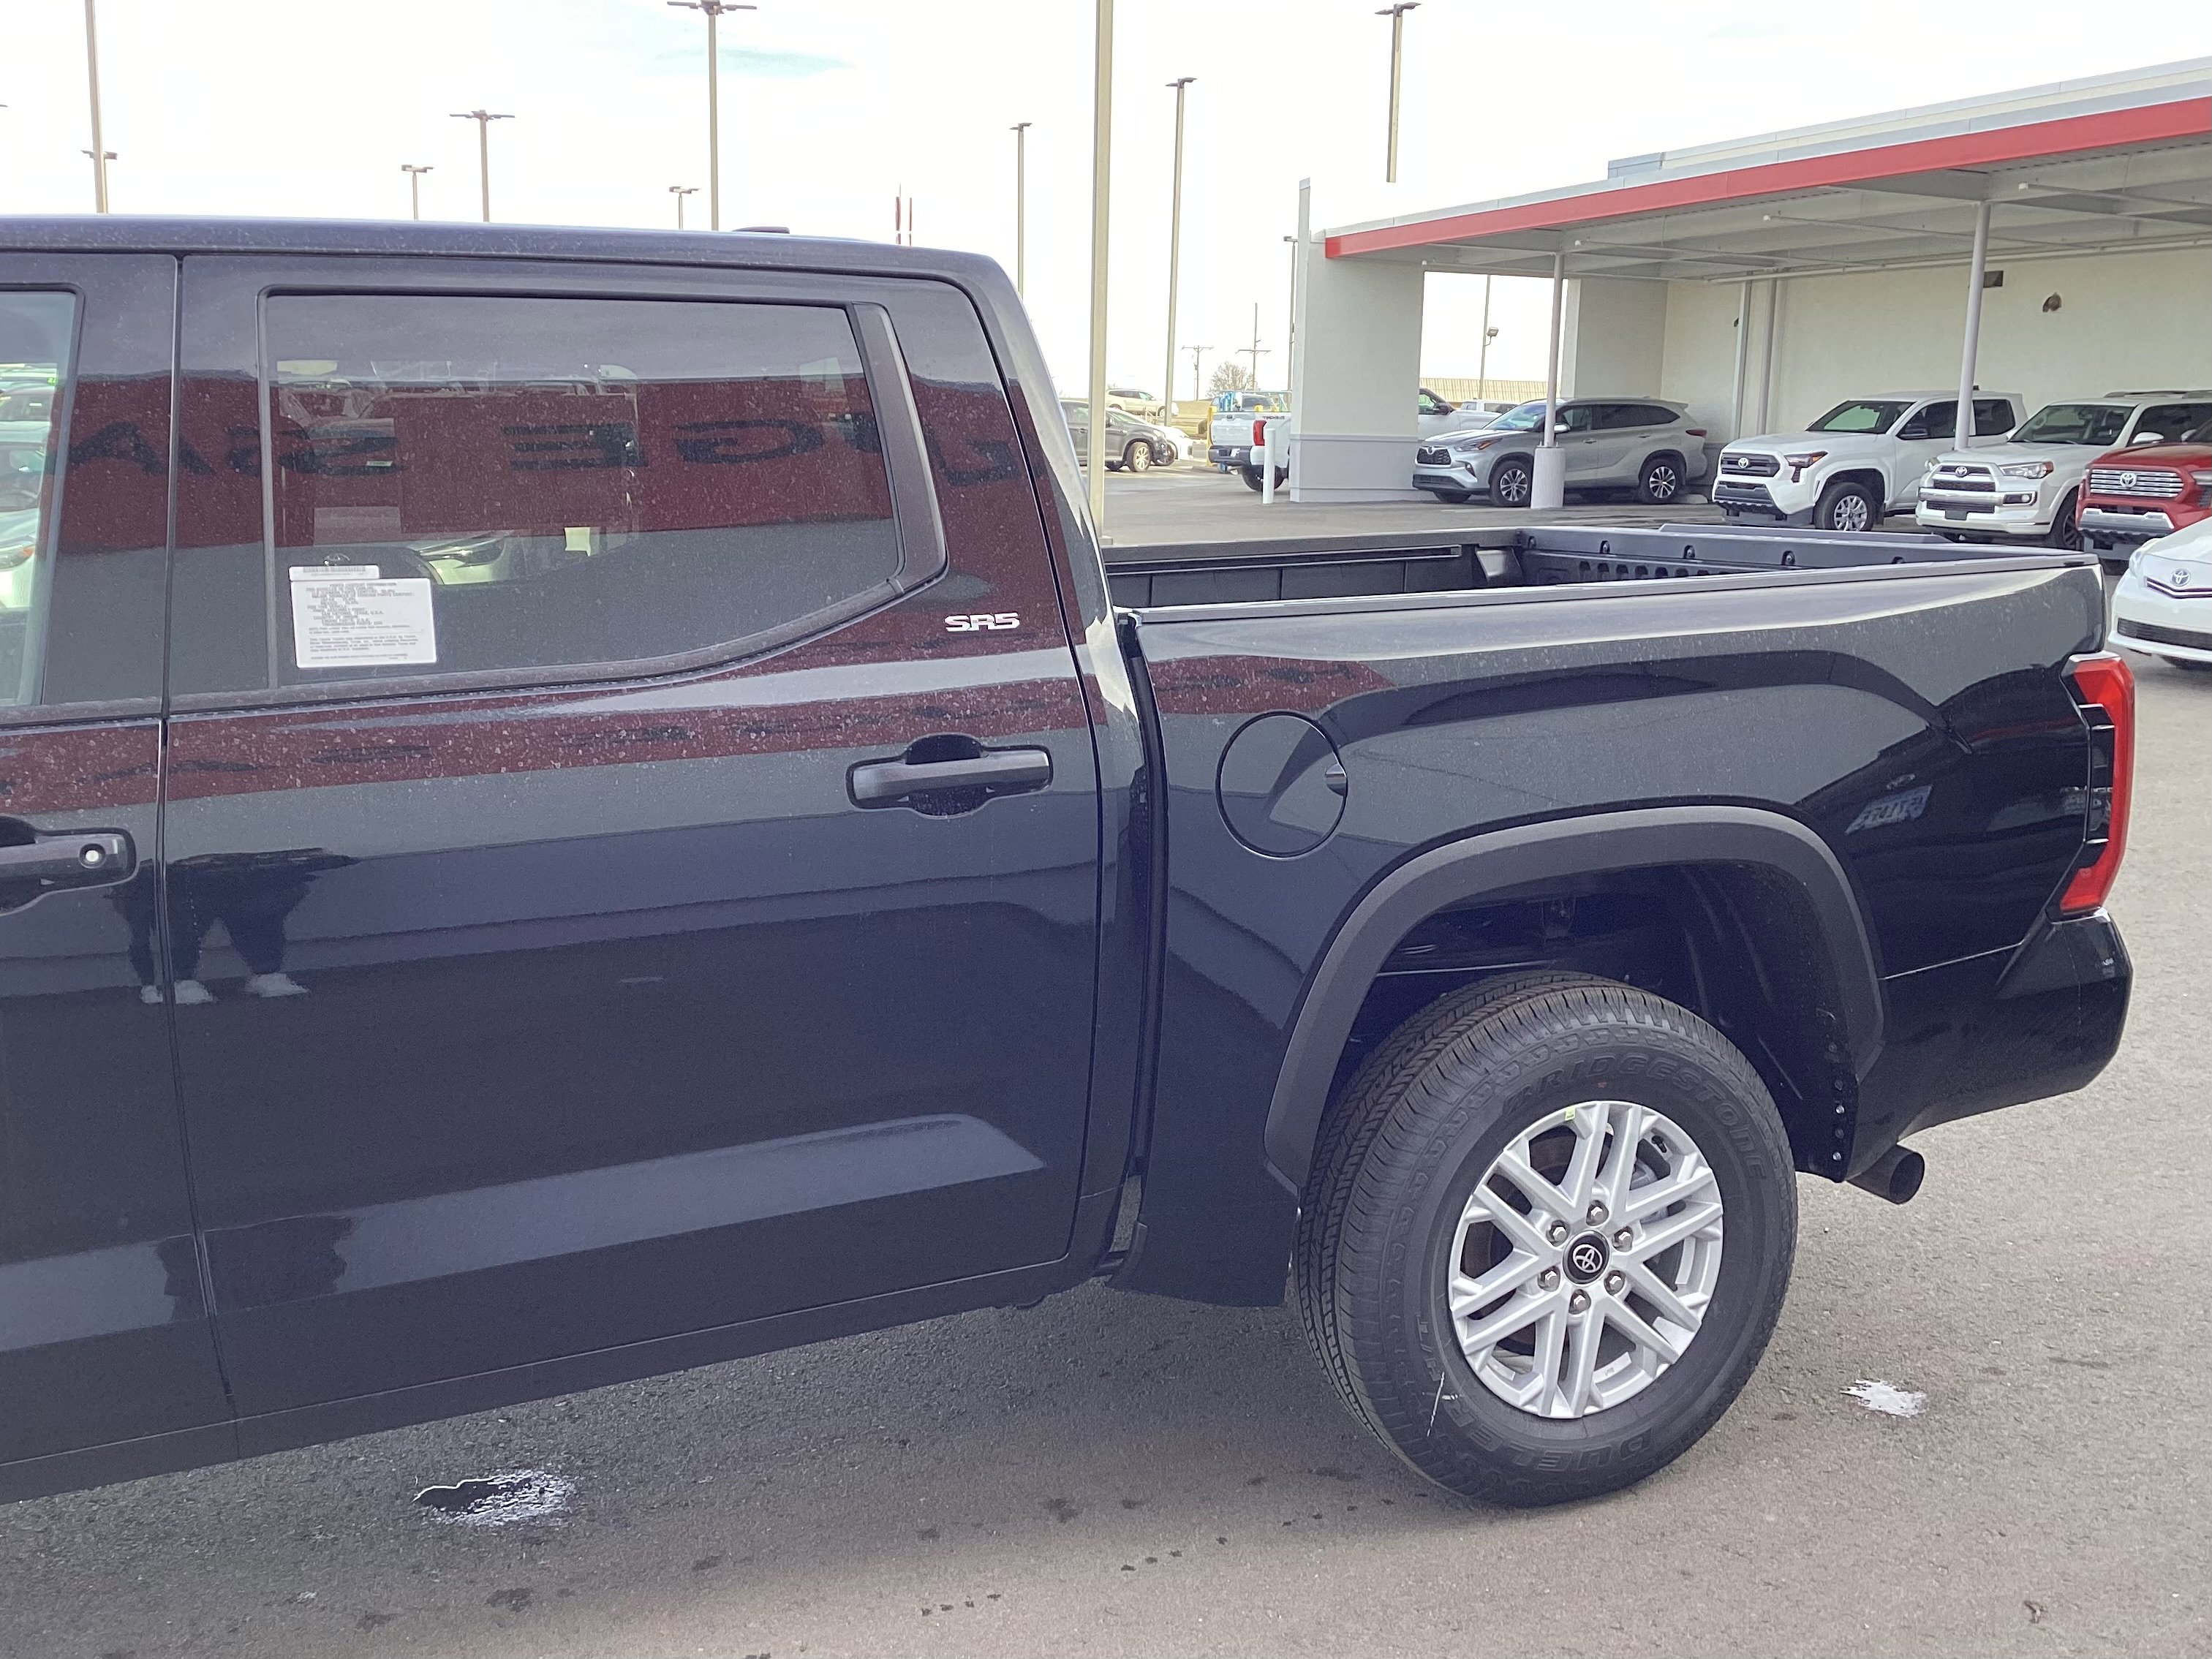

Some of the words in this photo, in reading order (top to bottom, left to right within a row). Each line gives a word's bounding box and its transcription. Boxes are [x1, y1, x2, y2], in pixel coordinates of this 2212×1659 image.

[944, 612, 1021, 632] SR5
[1503, 1052, 1770, 1179] BRIDGESTONE
[1442, 1400, 1654, 1470] DUELER
